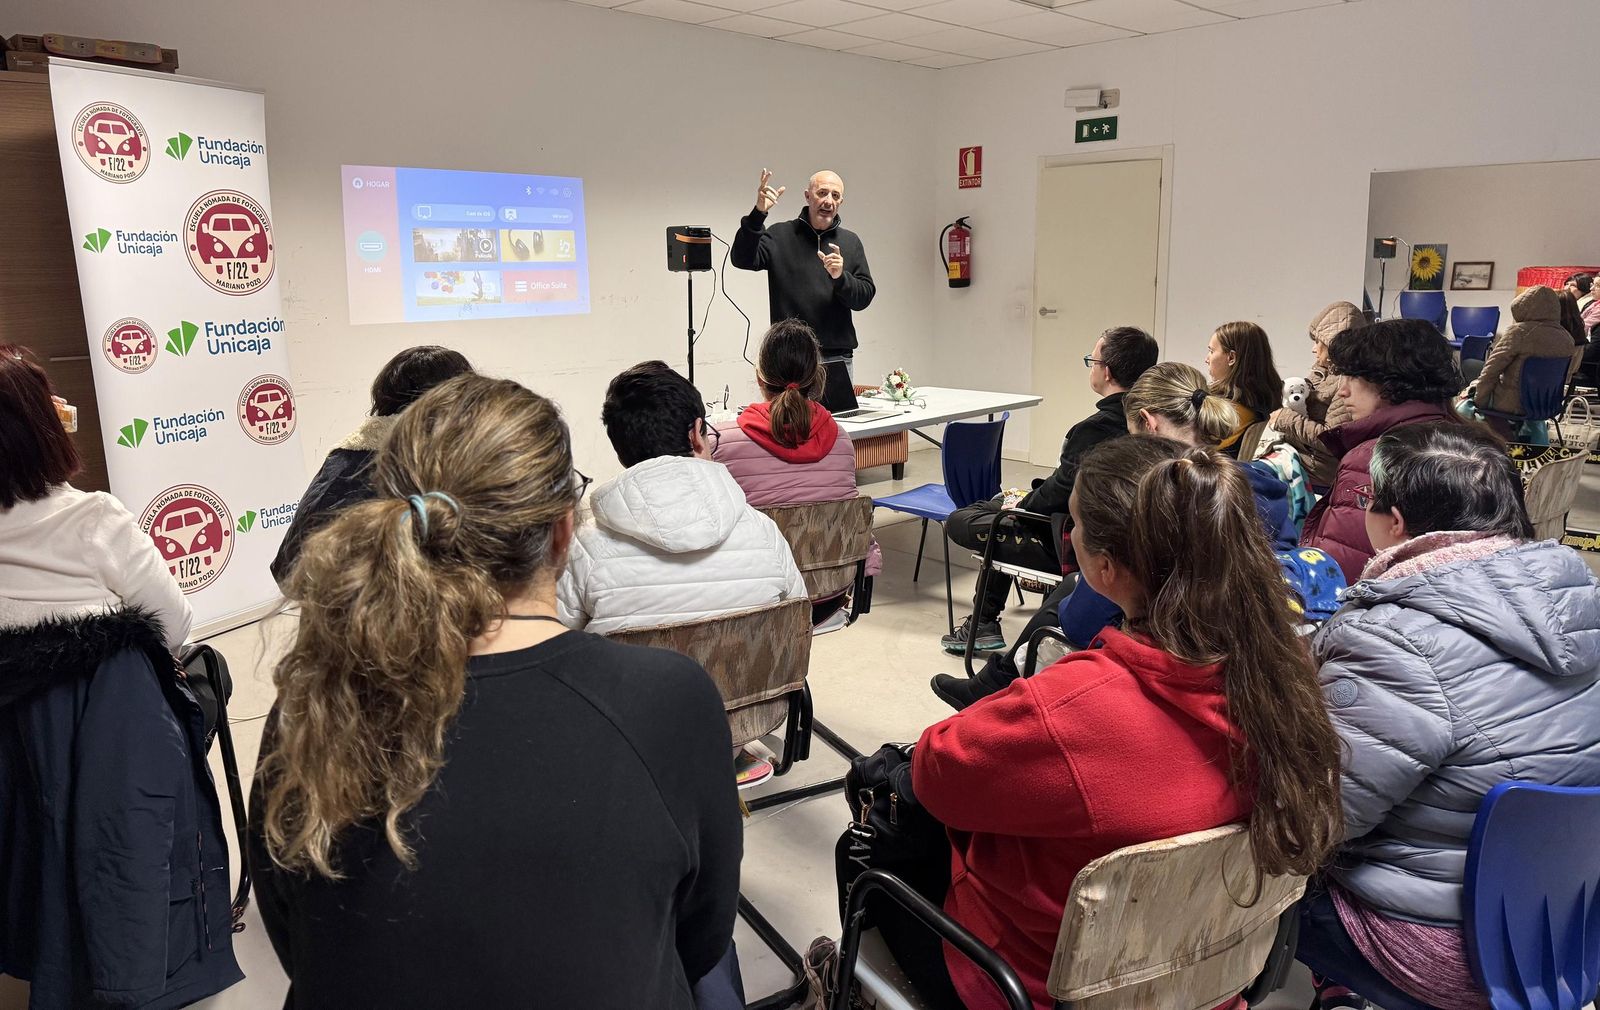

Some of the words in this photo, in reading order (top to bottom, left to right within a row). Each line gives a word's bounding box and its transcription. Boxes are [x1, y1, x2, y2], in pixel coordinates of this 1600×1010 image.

[197, 136, 265, 155] Fundación
[108, 157, 126, 171] F/22
[199, 150, 251, 169] Unicaja
[366, 180, 390, 189] HOGAR
[959, 178, 981, 187] EXTINTOR
[190, 206, 206, 232] ESCUELA
[232, 196, 241, 204] DE
[116, 230, 178, 243] Fundación
[118, 242, 163, 257] Unicaja
[226, 261, 249, 280] F/22
[216, 279, 246, 290] MARIANO
[246, 277, 262, 288] POZO
[205, 316, 286, 338] Fundación
[207, 335, 271, 355] Unicaja
[153, 408, 225, 431] Fundación
[265, 421, 281, 435] F/22
[155, 426, 208, 446] Unicaja
[260, 500, 300, 519] Fundac
[142, 509, 158, 535] SCUELA
[179, 556, 202, 579] F/22
[178, 579, 198, 589] RIANO
[199, 569, 215, 581] POZO
